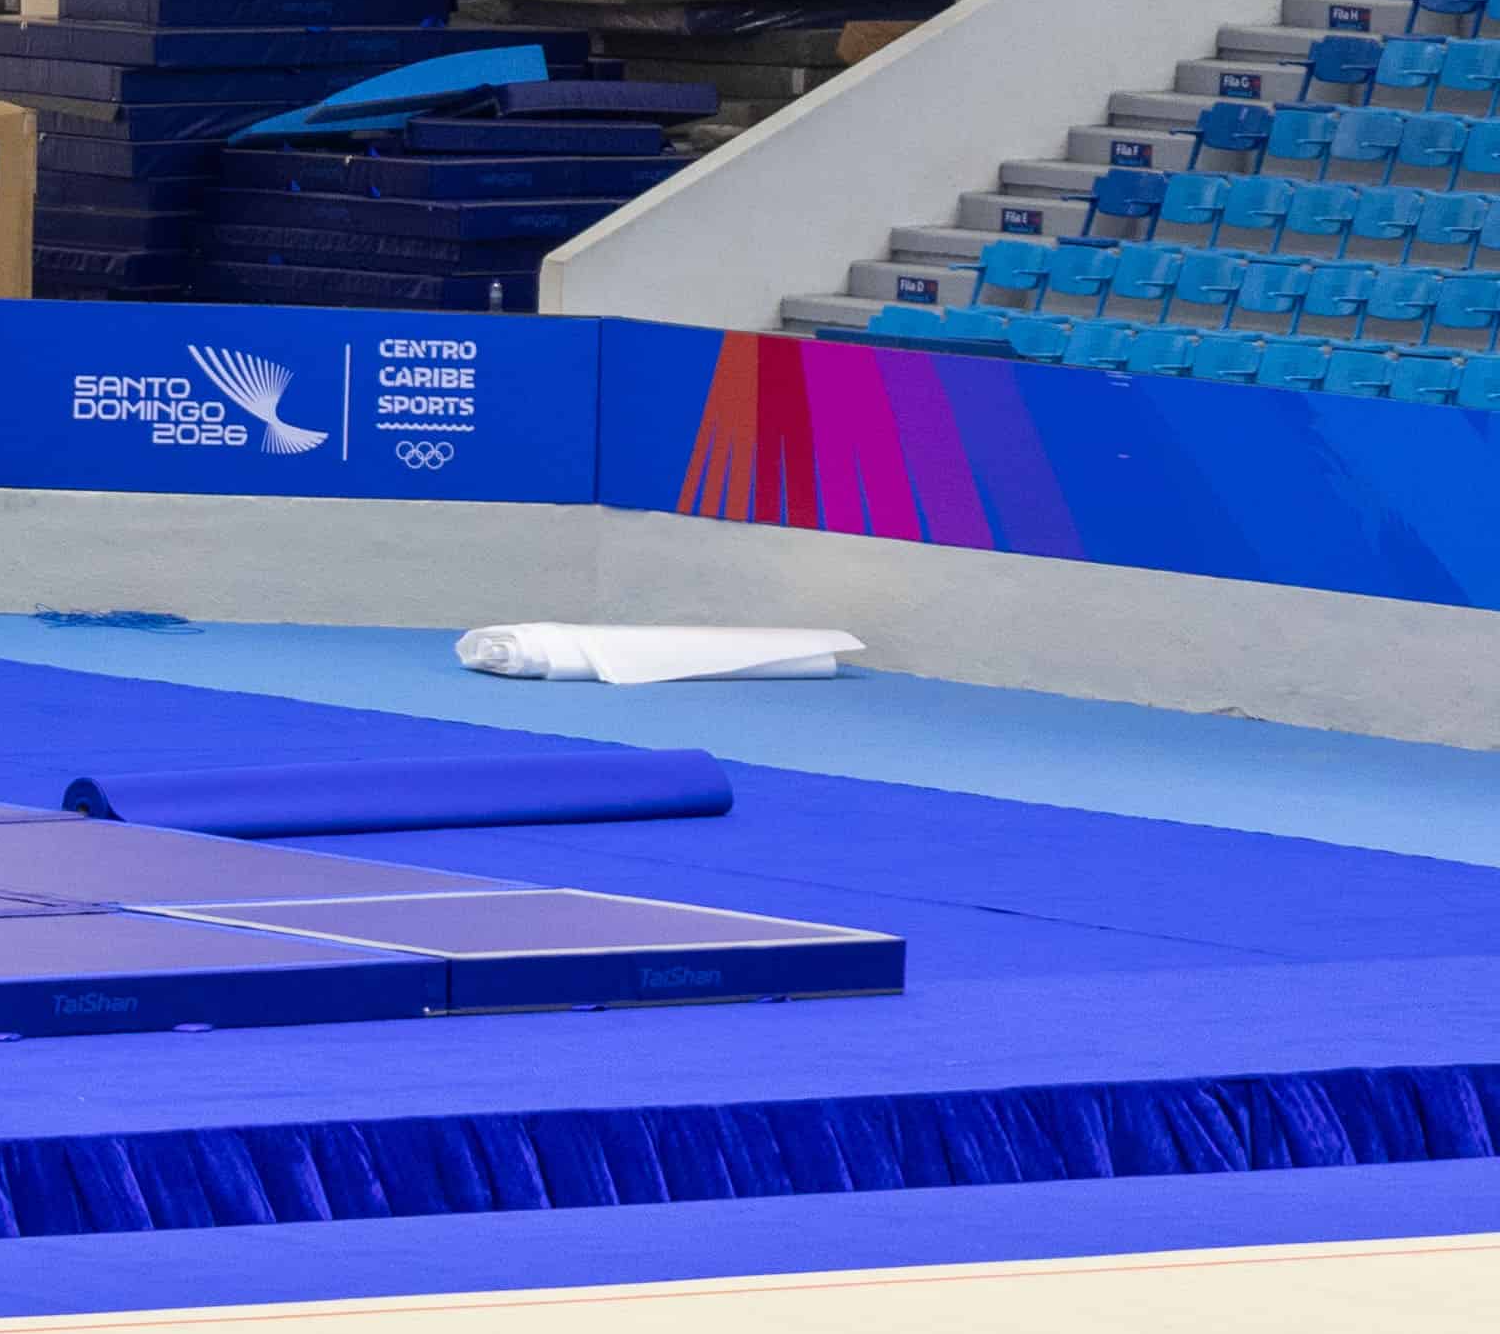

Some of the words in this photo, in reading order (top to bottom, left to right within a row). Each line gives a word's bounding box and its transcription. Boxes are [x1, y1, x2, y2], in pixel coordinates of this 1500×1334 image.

[379, 338, 477, 360] CENTRO
[74, 376, 191, 399] SANTO
[378, 366, 476, 389] CARIBE
[73, 399, 226, 422] DOMINGO
[377, 395, 475, 416] SPORTS
[152, 424, 248, 446] 2026
[639, 967, 721, 988] TaiShan
[48, 992, 139, 1017] TaiShan
